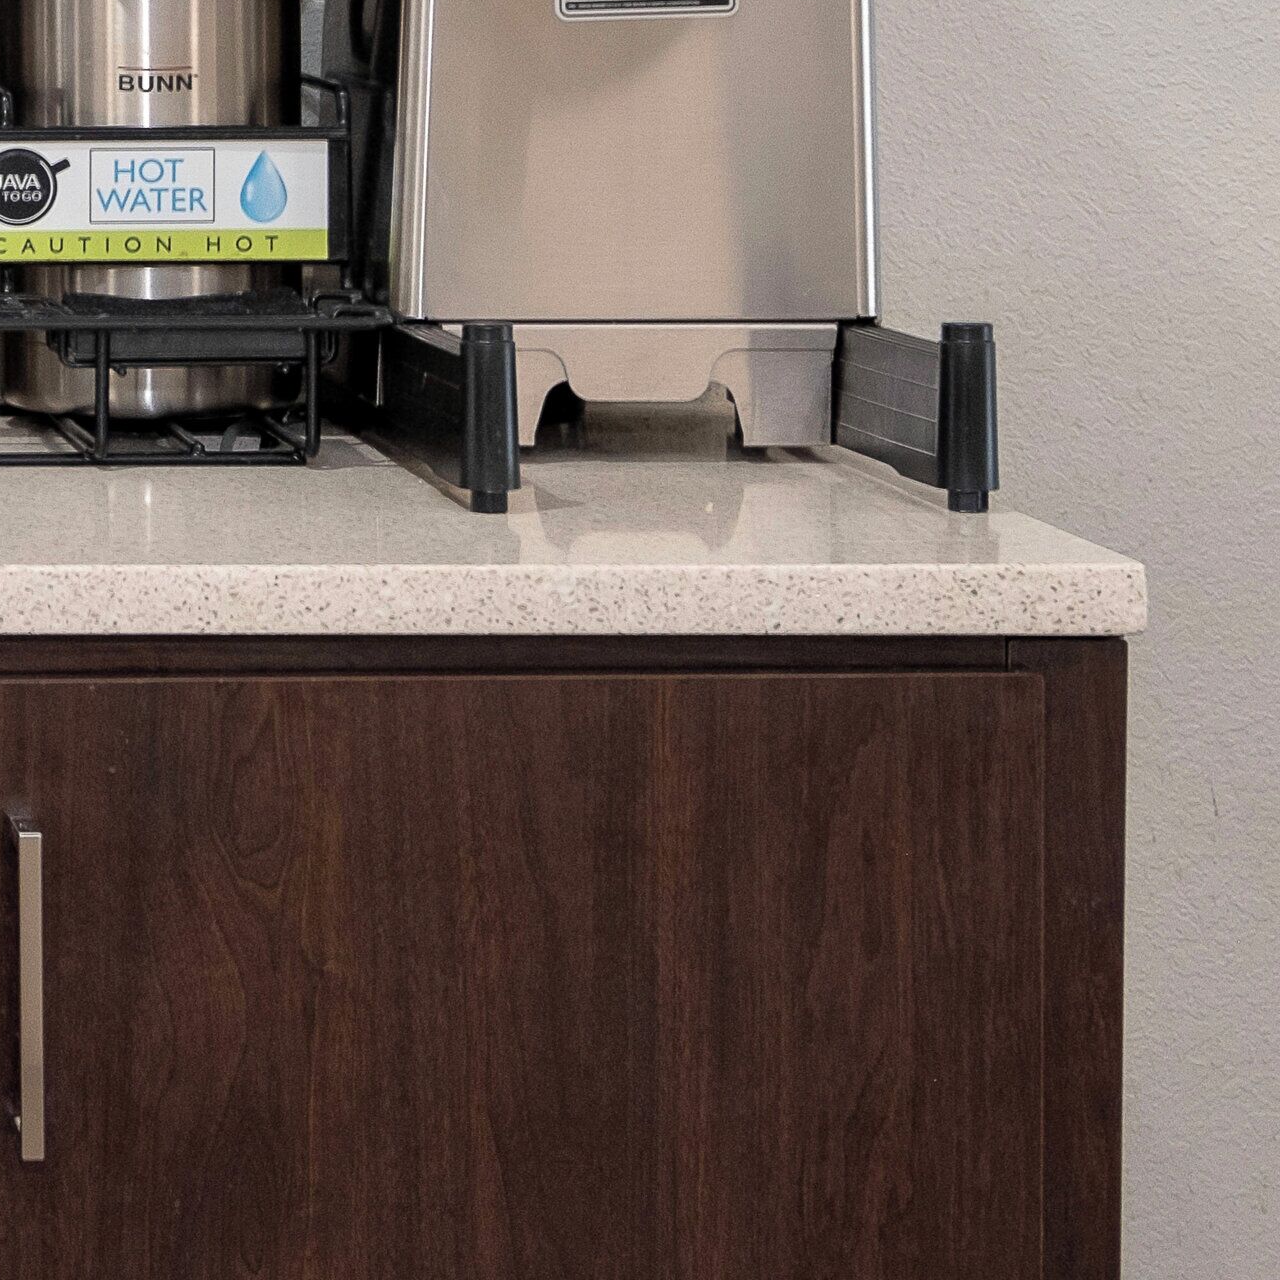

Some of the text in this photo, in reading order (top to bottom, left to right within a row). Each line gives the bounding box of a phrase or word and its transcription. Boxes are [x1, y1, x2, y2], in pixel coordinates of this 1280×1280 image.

[119, 74, 192, 92] BUNN
[114, 159, 184, 183] HOT
[96, 188, 207, 212] WATER
[207, 235, 278, 253] HOT
